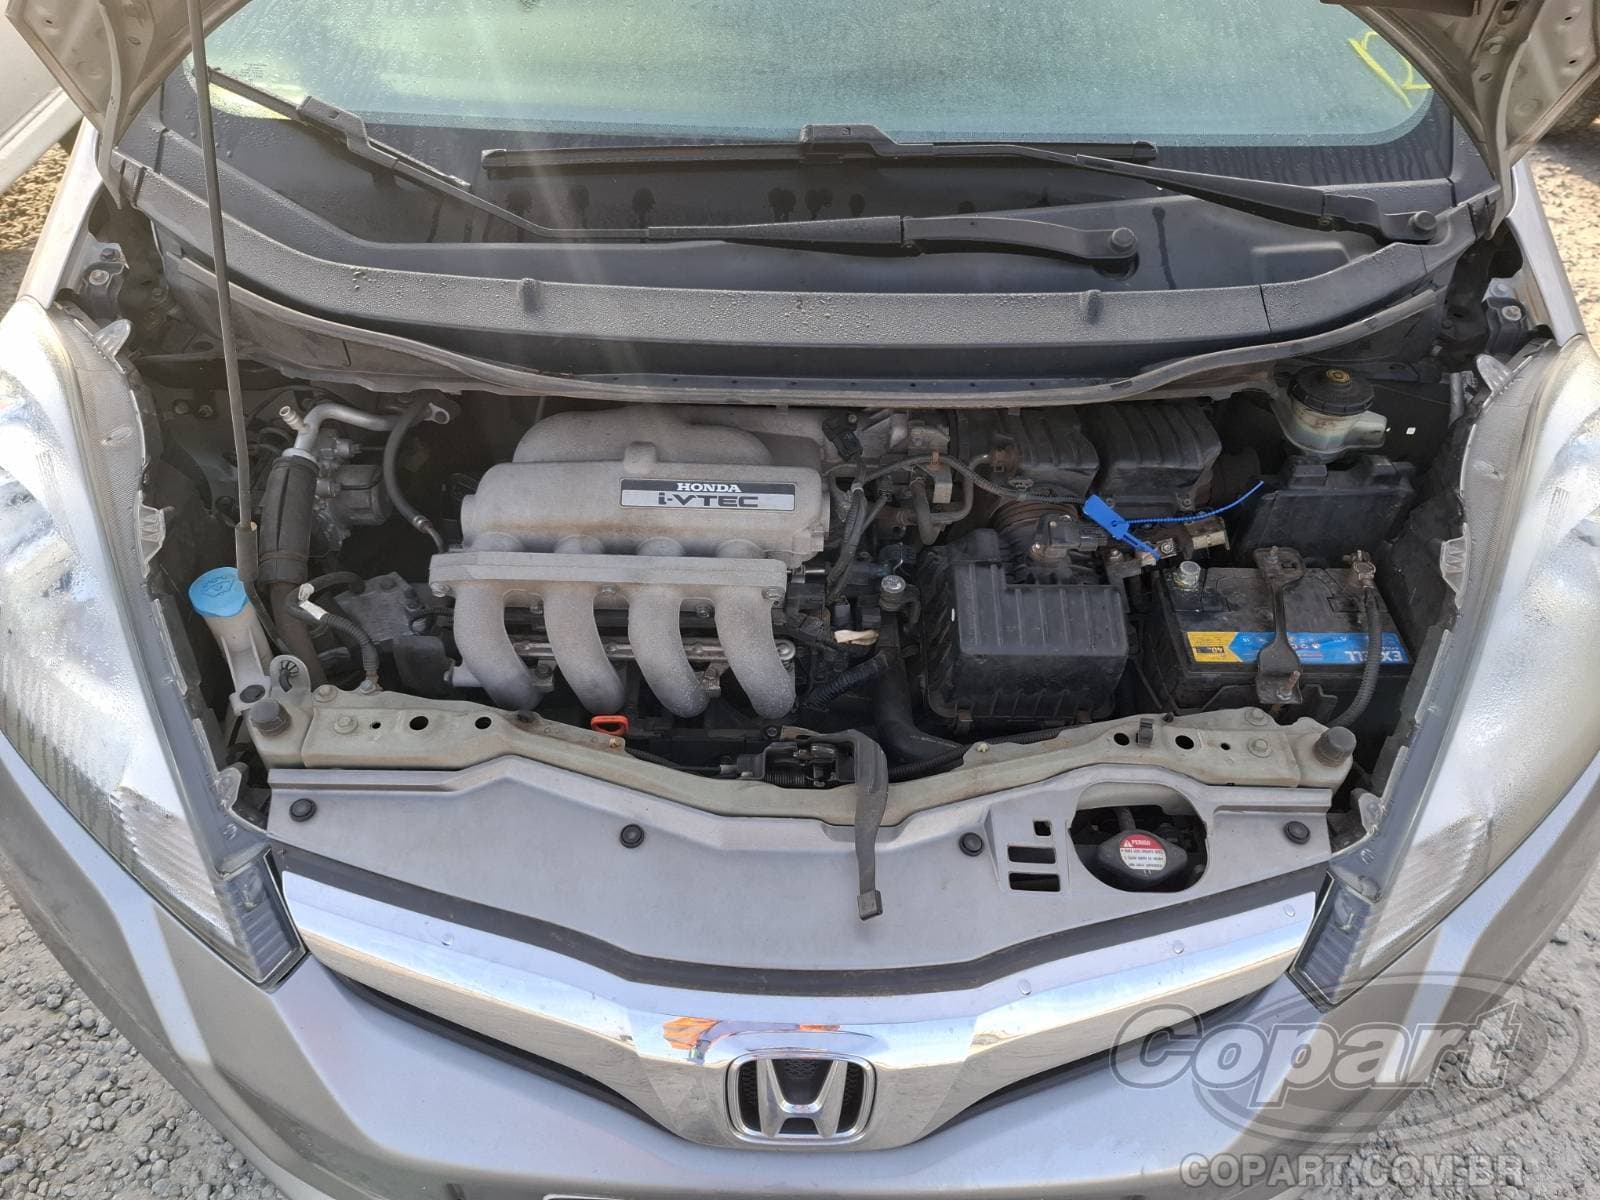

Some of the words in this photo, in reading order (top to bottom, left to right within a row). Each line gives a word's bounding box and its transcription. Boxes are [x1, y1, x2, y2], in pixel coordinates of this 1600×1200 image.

[676, 482, 742, 493] HONDA
[658, 492, 758, 508] i-VTEC
[1344, 650, 1403, 661] EXELL
